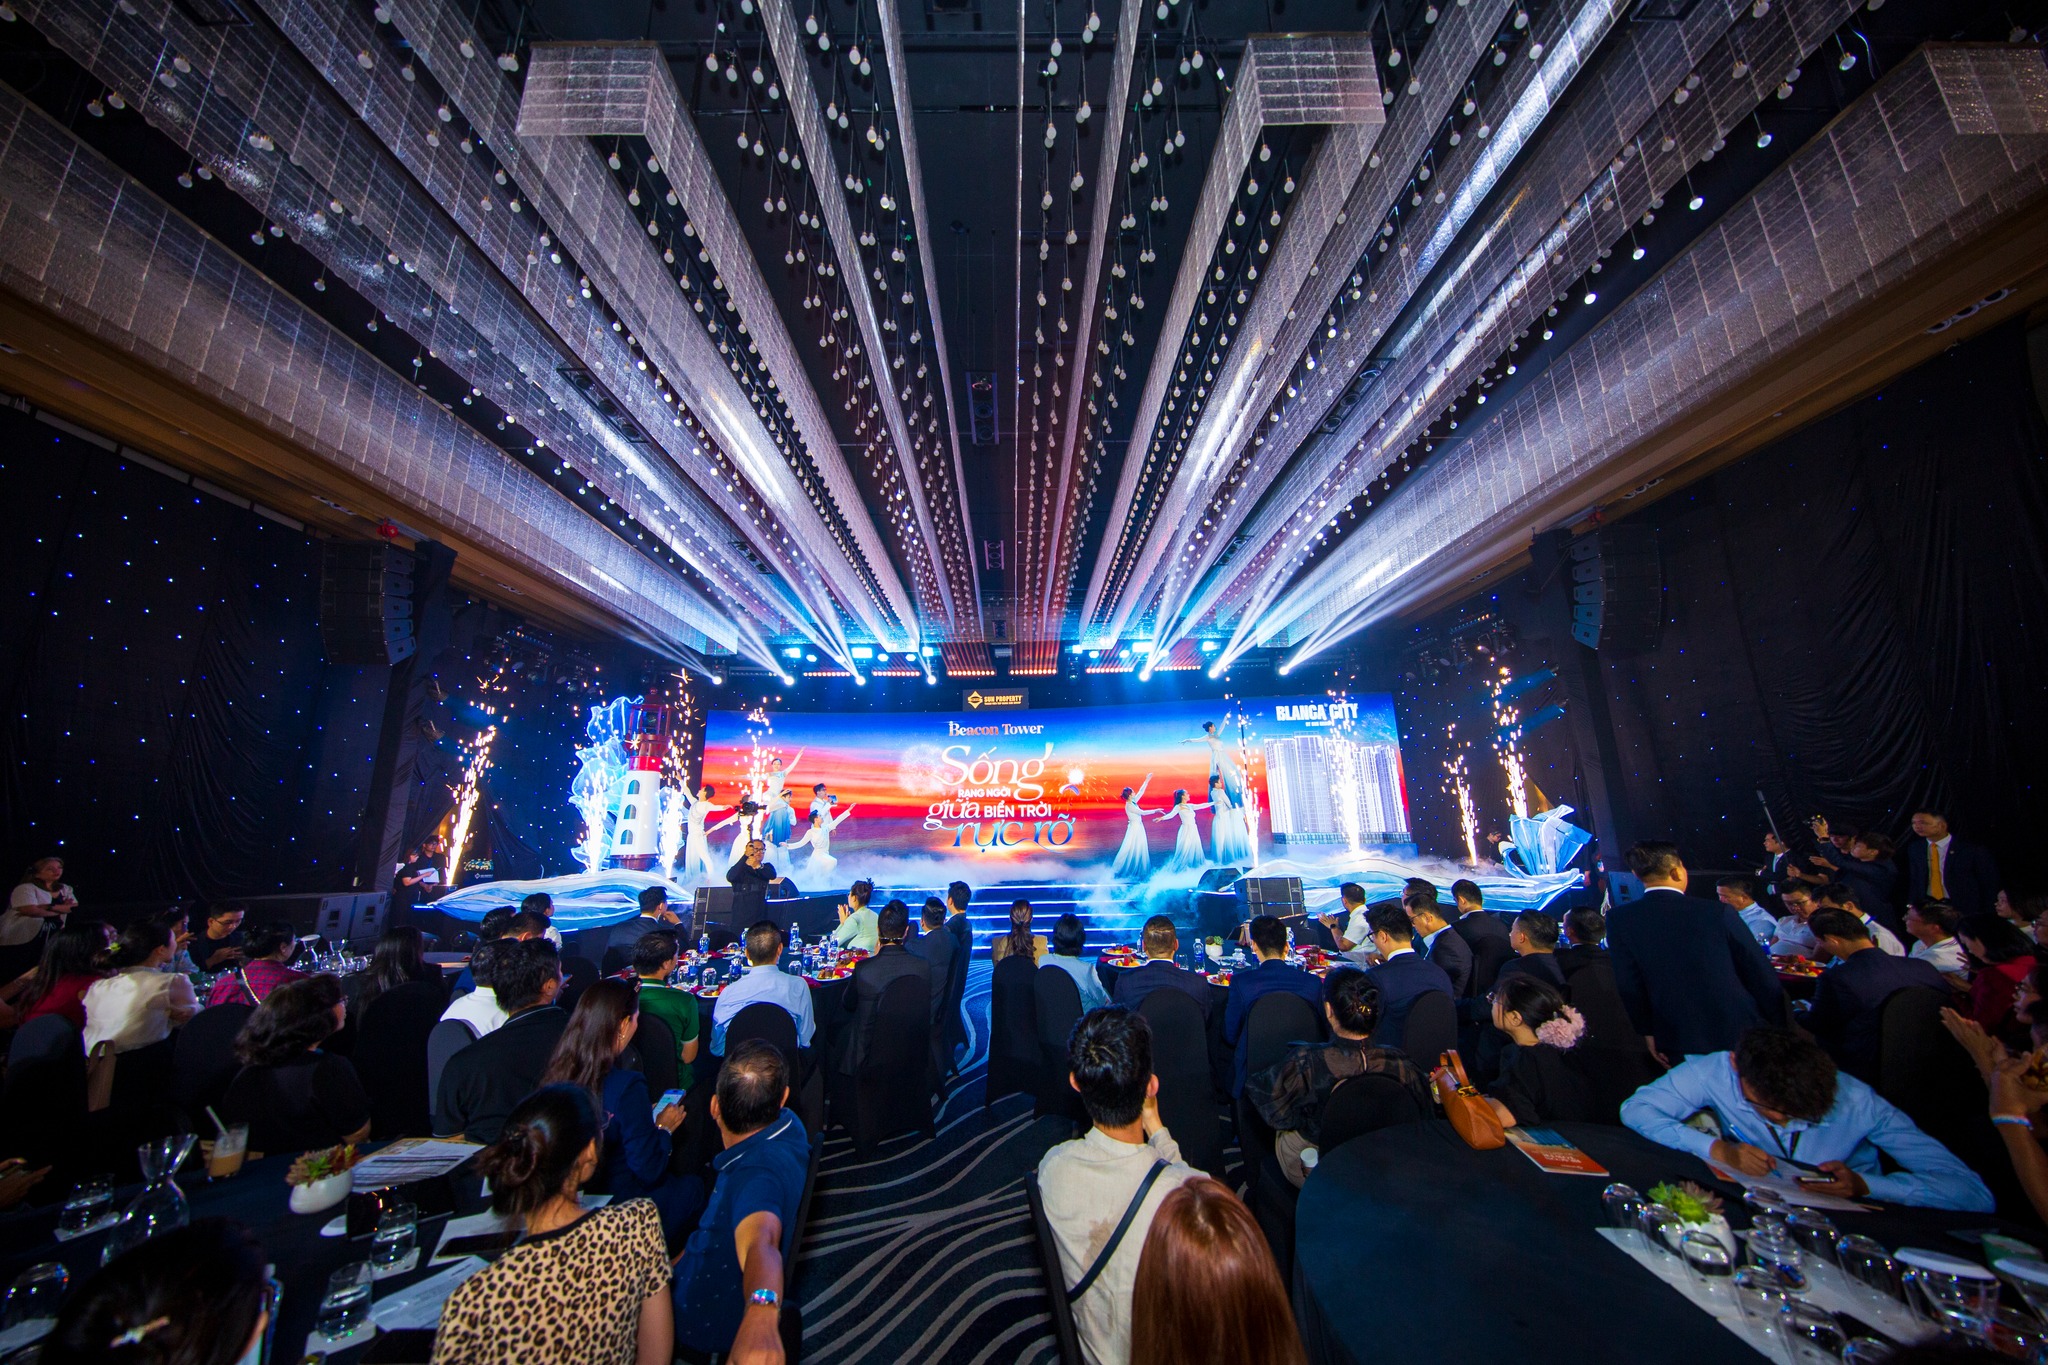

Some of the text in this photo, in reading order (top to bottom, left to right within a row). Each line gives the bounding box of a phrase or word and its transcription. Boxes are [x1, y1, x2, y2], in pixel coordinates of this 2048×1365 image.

[949, 721, 1044, 736] Beacon Tower
[1276, 703, 1358, 721] BLANCA CITY
[934, 742, 1054, 801] Sống
[922, 798, 1052, 831] giữa BIỂN TRỜI
[952, 813, 1077, 853] rực rỡ
